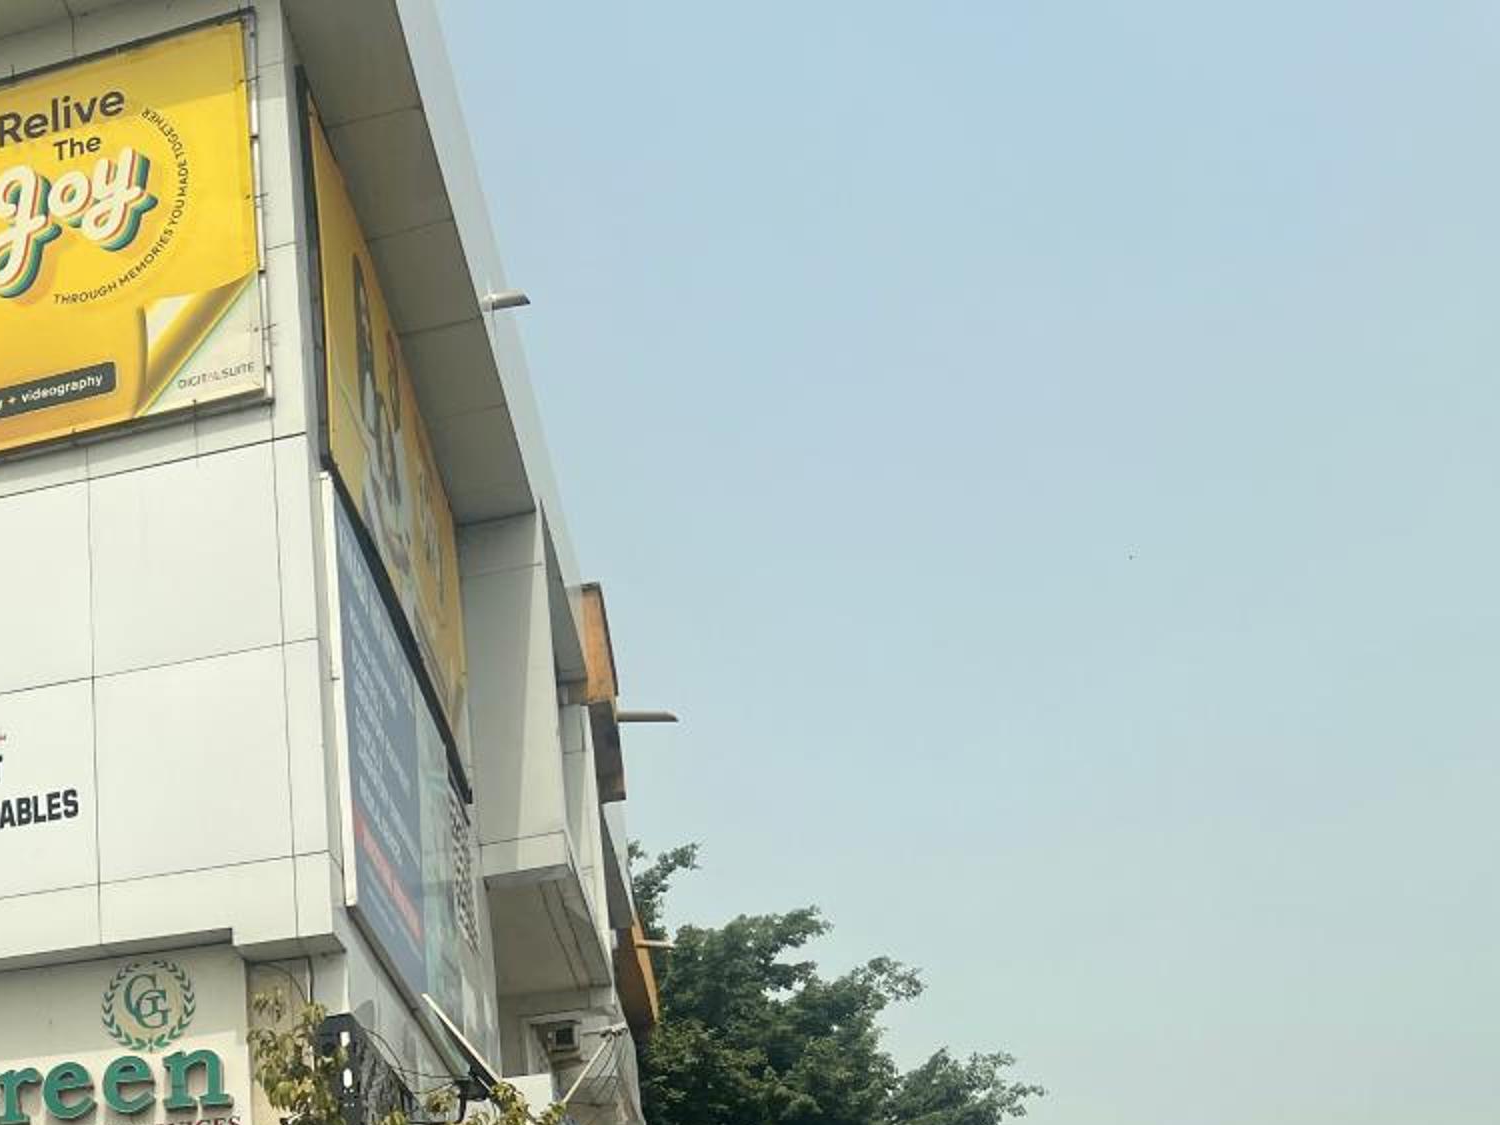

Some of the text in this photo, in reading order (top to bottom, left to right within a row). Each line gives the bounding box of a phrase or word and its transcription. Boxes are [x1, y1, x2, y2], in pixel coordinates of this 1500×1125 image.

[53, 136, 102, 162] The
[53, 107, 189, 305] THROUGH MEMORIES YOU MADE TOGETHER
[21, 373, 103, 403] videography
